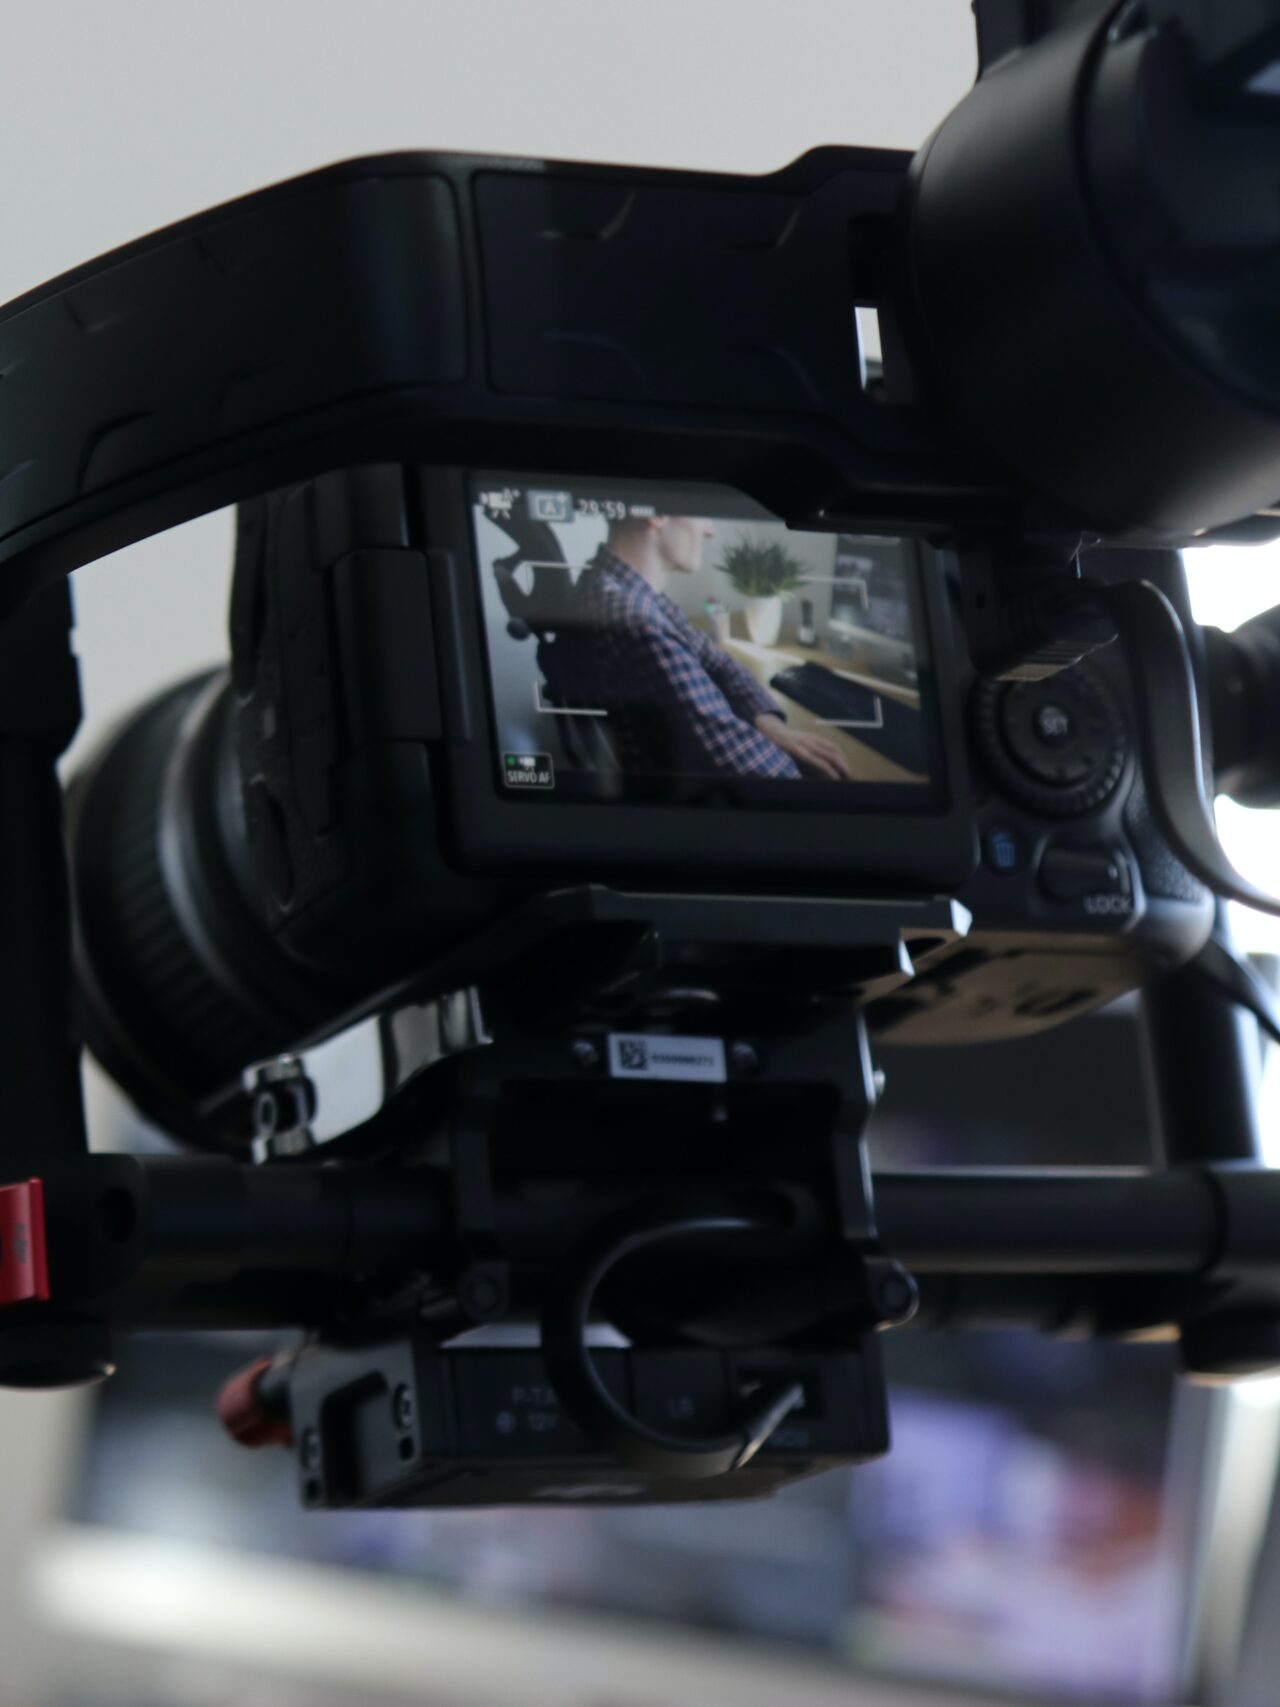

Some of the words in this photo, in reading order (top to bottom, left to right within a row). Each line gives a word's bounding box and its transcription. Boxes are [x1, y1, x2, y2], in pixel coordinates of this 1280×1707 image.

[578, 499, 626, 519] 29:59
[1043, 716, 1068, 736] SET
[508, 770, 537, 784] SERVO
[539, 772, 550, 784] AF
[1083, 895, 1131, 914] LOCK
